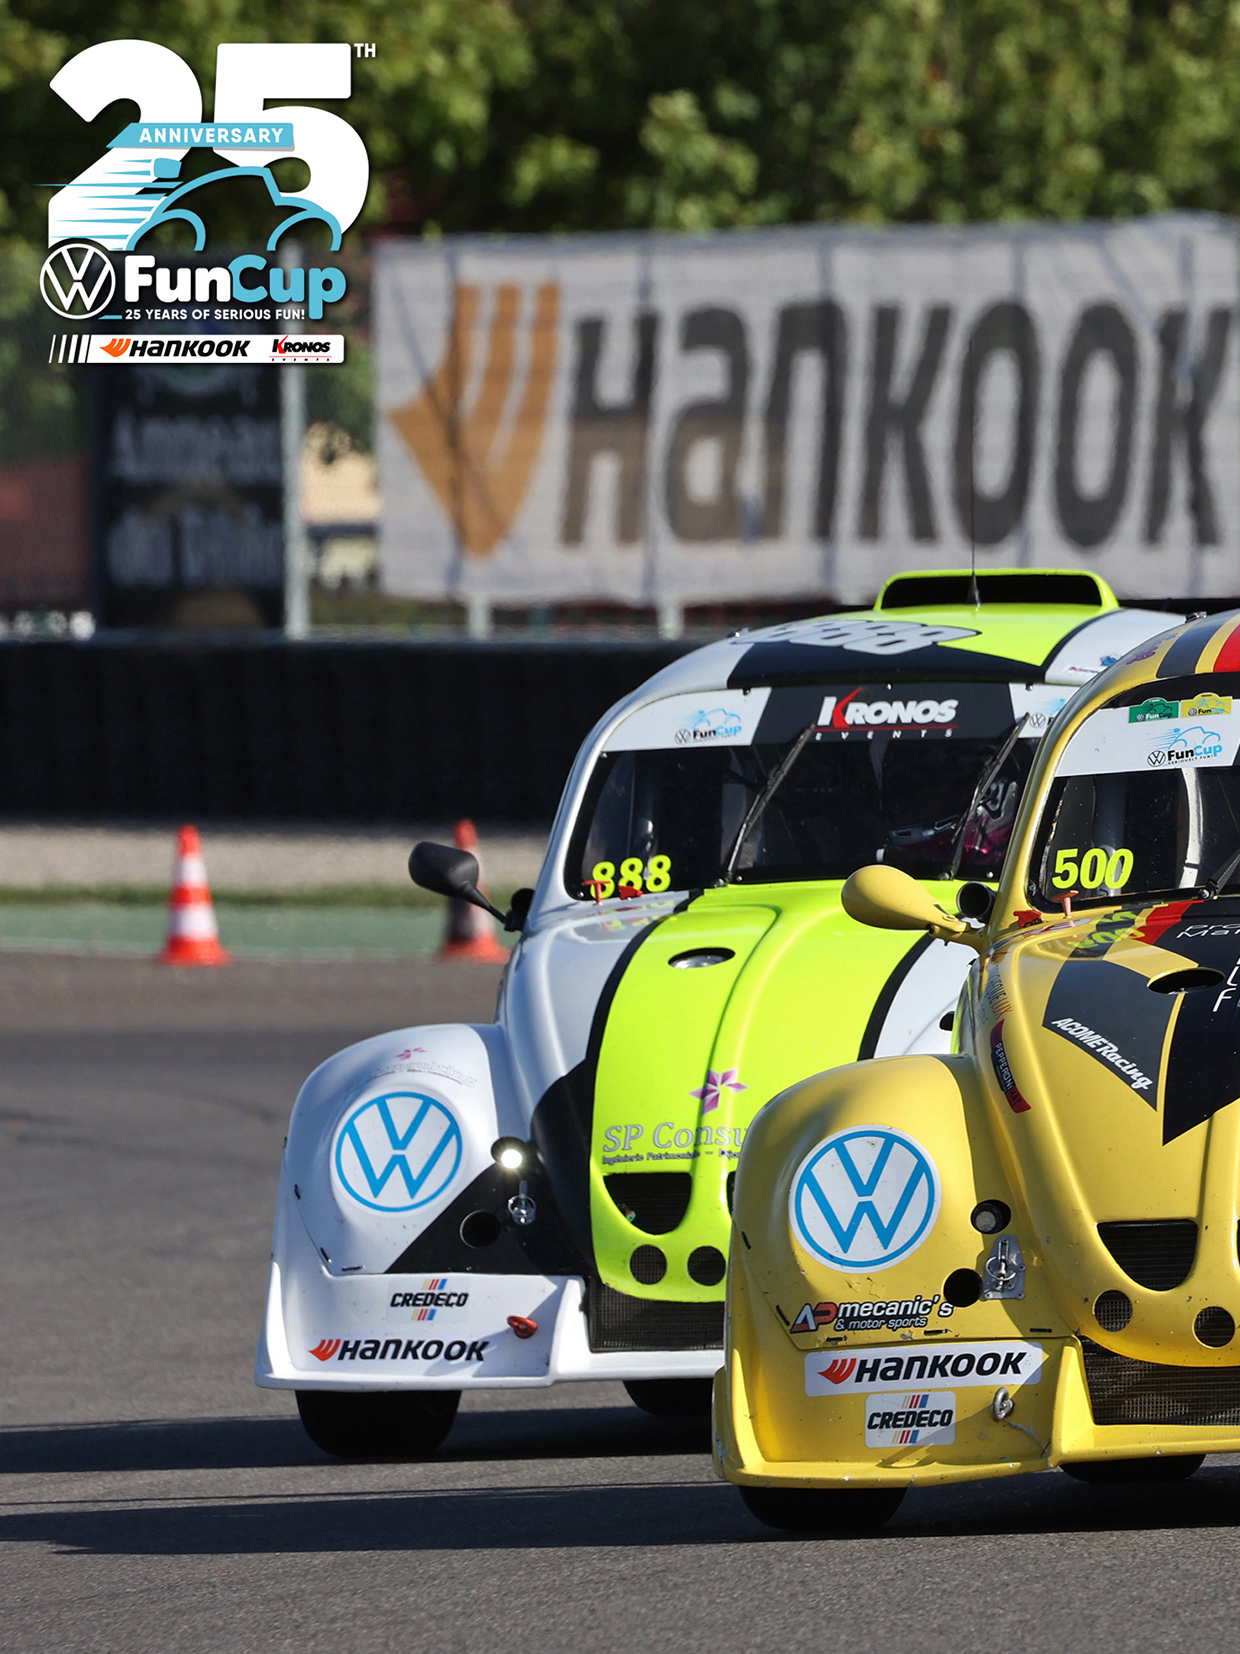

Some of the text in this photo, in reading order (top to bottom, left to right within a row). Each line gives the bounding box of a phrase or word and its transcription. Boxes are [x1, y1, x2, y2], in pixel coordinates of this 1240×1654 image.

[817, 688, 959, 727] KRONOS
[693, 725, 742, 739] FunCup
[814, 730, 953, 740] EVENTS
[1167, 744, 1223, 761] FunCup
[590, 854, 672, 899] 888
[1051, 847, 1134, 890] 500
[603, 1124, 644, 1152] SP
[390, 1292, 469, 1308] CREDECO
[835, 1316, 927, 1331] & motor sports
[867, 1409, 953, 1430] CREDECO
